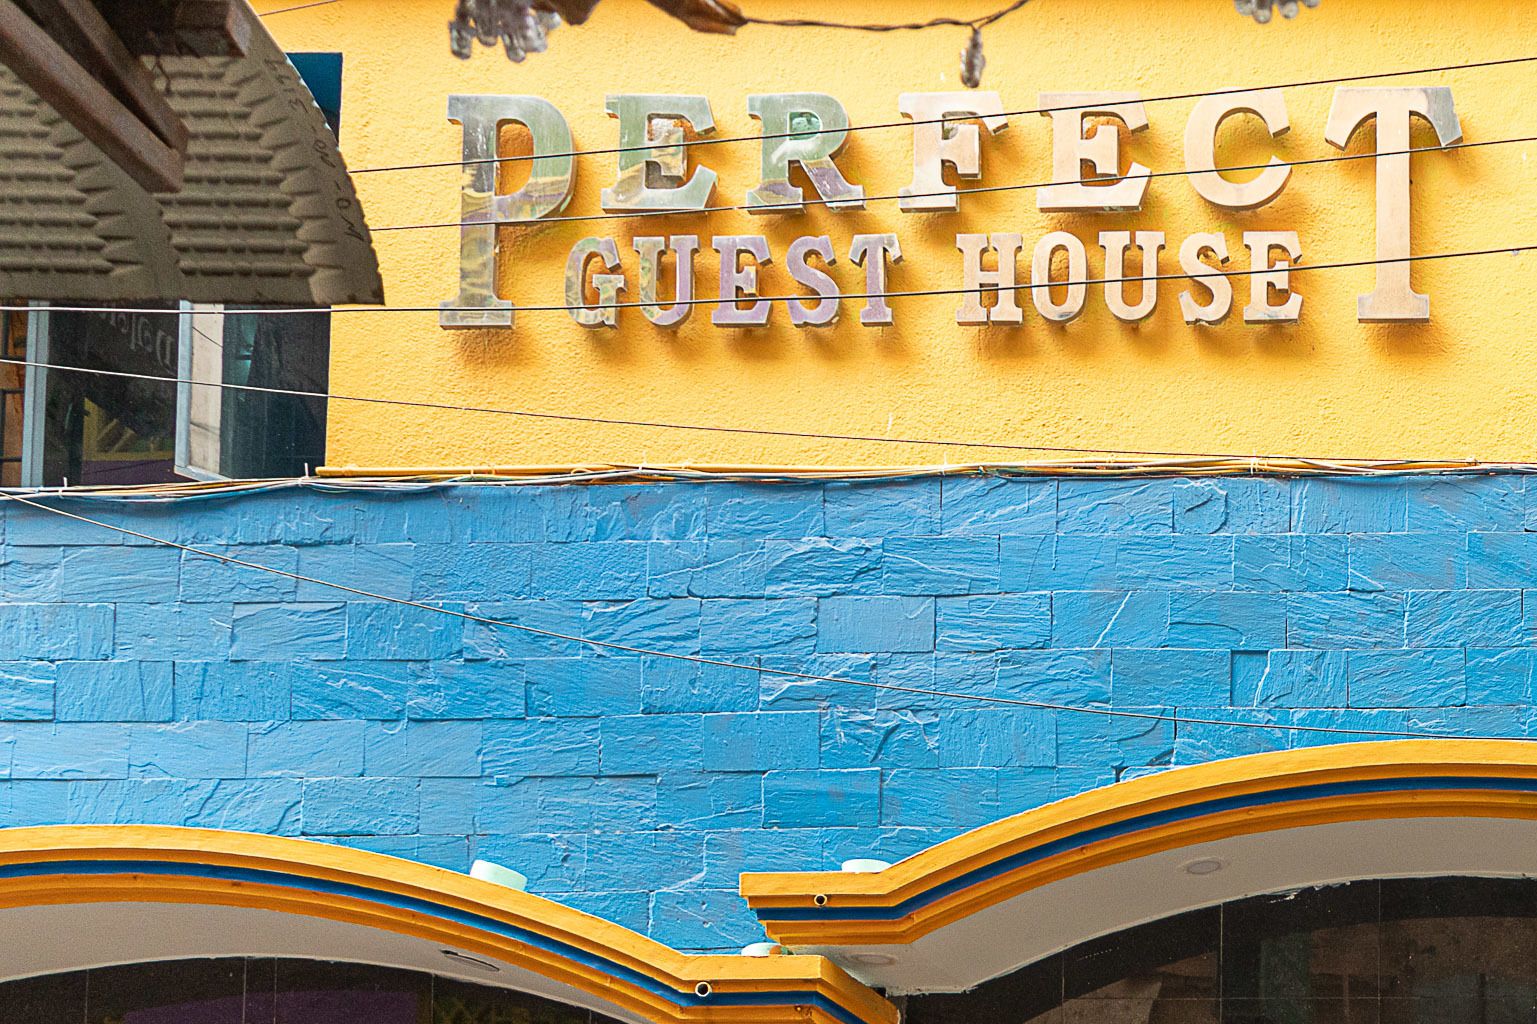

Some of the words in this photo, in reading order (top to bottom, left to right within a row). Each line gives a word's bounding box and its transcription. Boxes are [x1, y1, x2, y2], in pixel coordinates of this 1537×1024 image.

[439, 85, 1464, 330] PERFECT
[564, 233, 904, 330] GUEST
[955, 230, 1304, 326] HOUSE
